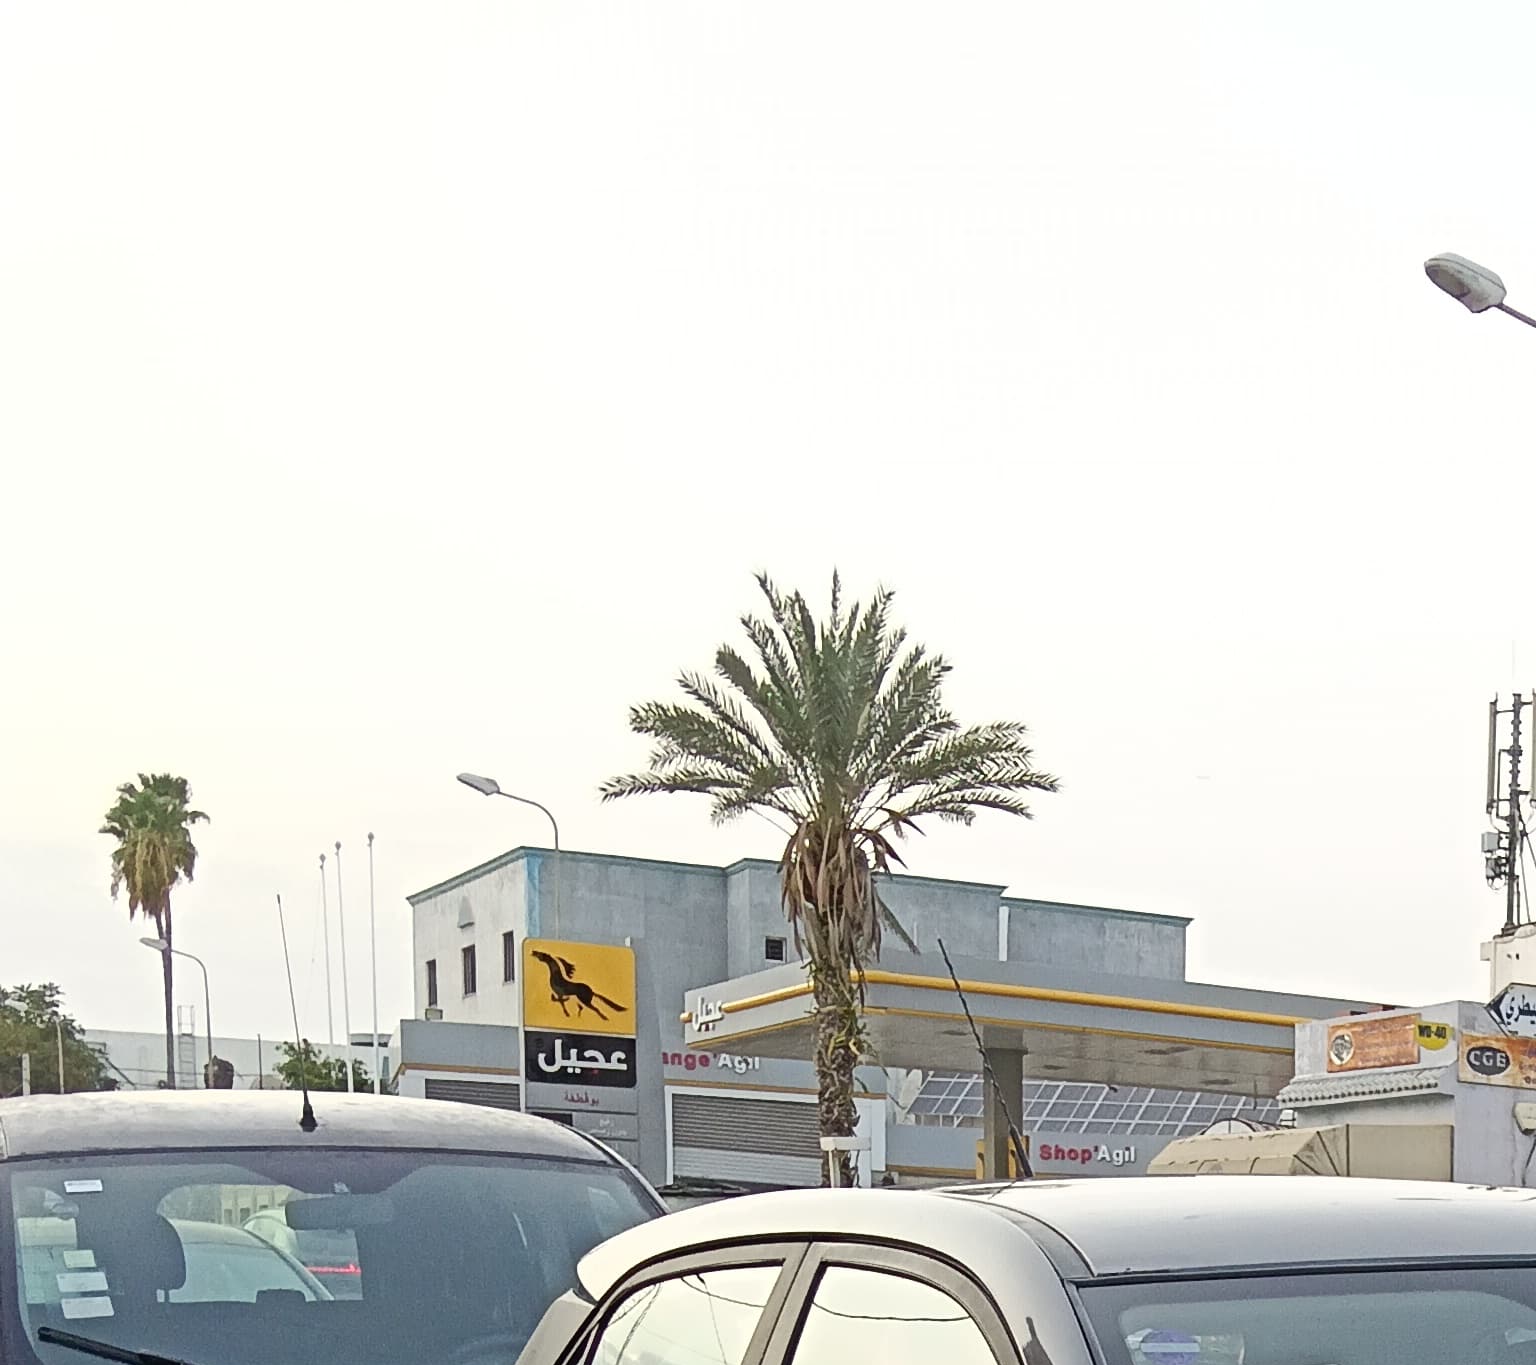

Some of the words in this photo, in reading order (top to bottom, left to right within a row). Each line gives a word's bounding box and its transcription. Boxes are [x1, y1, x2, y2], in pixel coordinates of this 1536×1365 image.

[1418, 1024, 1447, 1039] WD-40
[537, 1039, 627, 1075] عجيل
[1040, 1144, 1136, 1167] Shop'Agil
